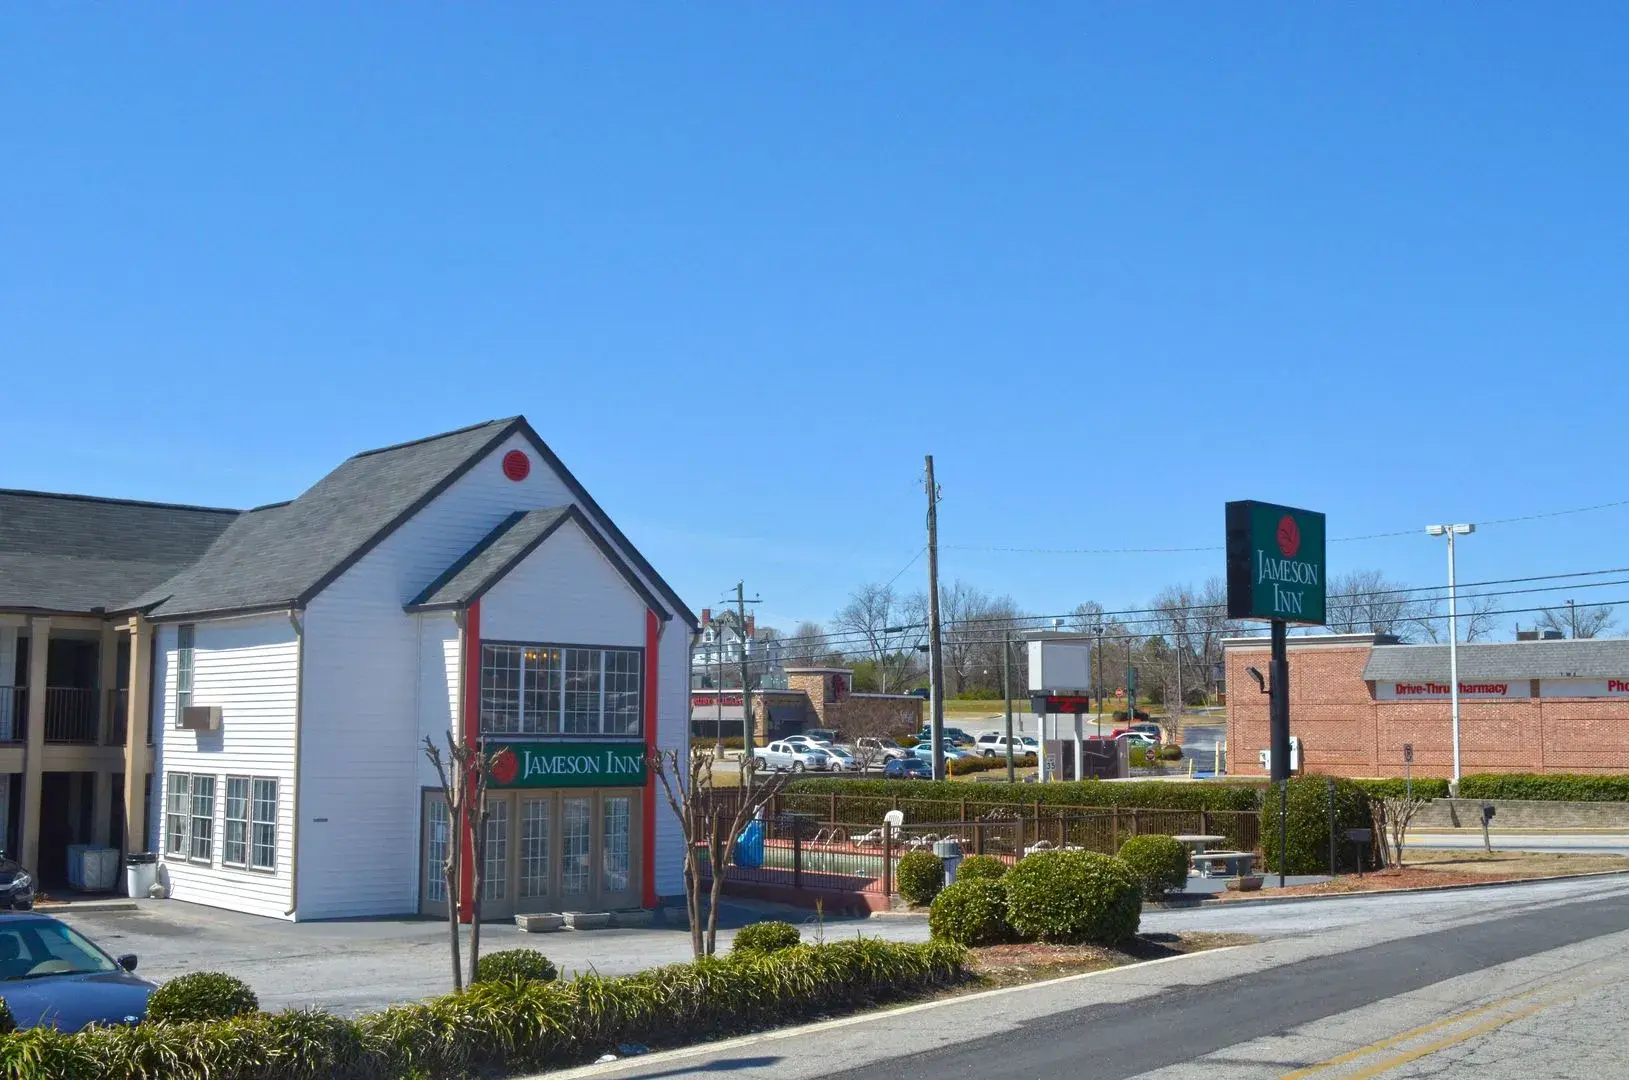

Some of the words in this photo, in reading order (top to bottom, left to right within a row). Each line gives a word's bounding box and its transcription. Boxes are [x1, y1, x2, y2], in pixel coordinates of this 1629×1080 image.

[1257, 549, 1318, 585] JAMESON
[1273, 583, 1302, 614] INN
[1395, 683, 1450, 695] Drive-Thru
[1457, 682, 1508, 695] harmacy
[523, 751, 600, 780] JAMESON
[605, 751, 641, 774] INN
